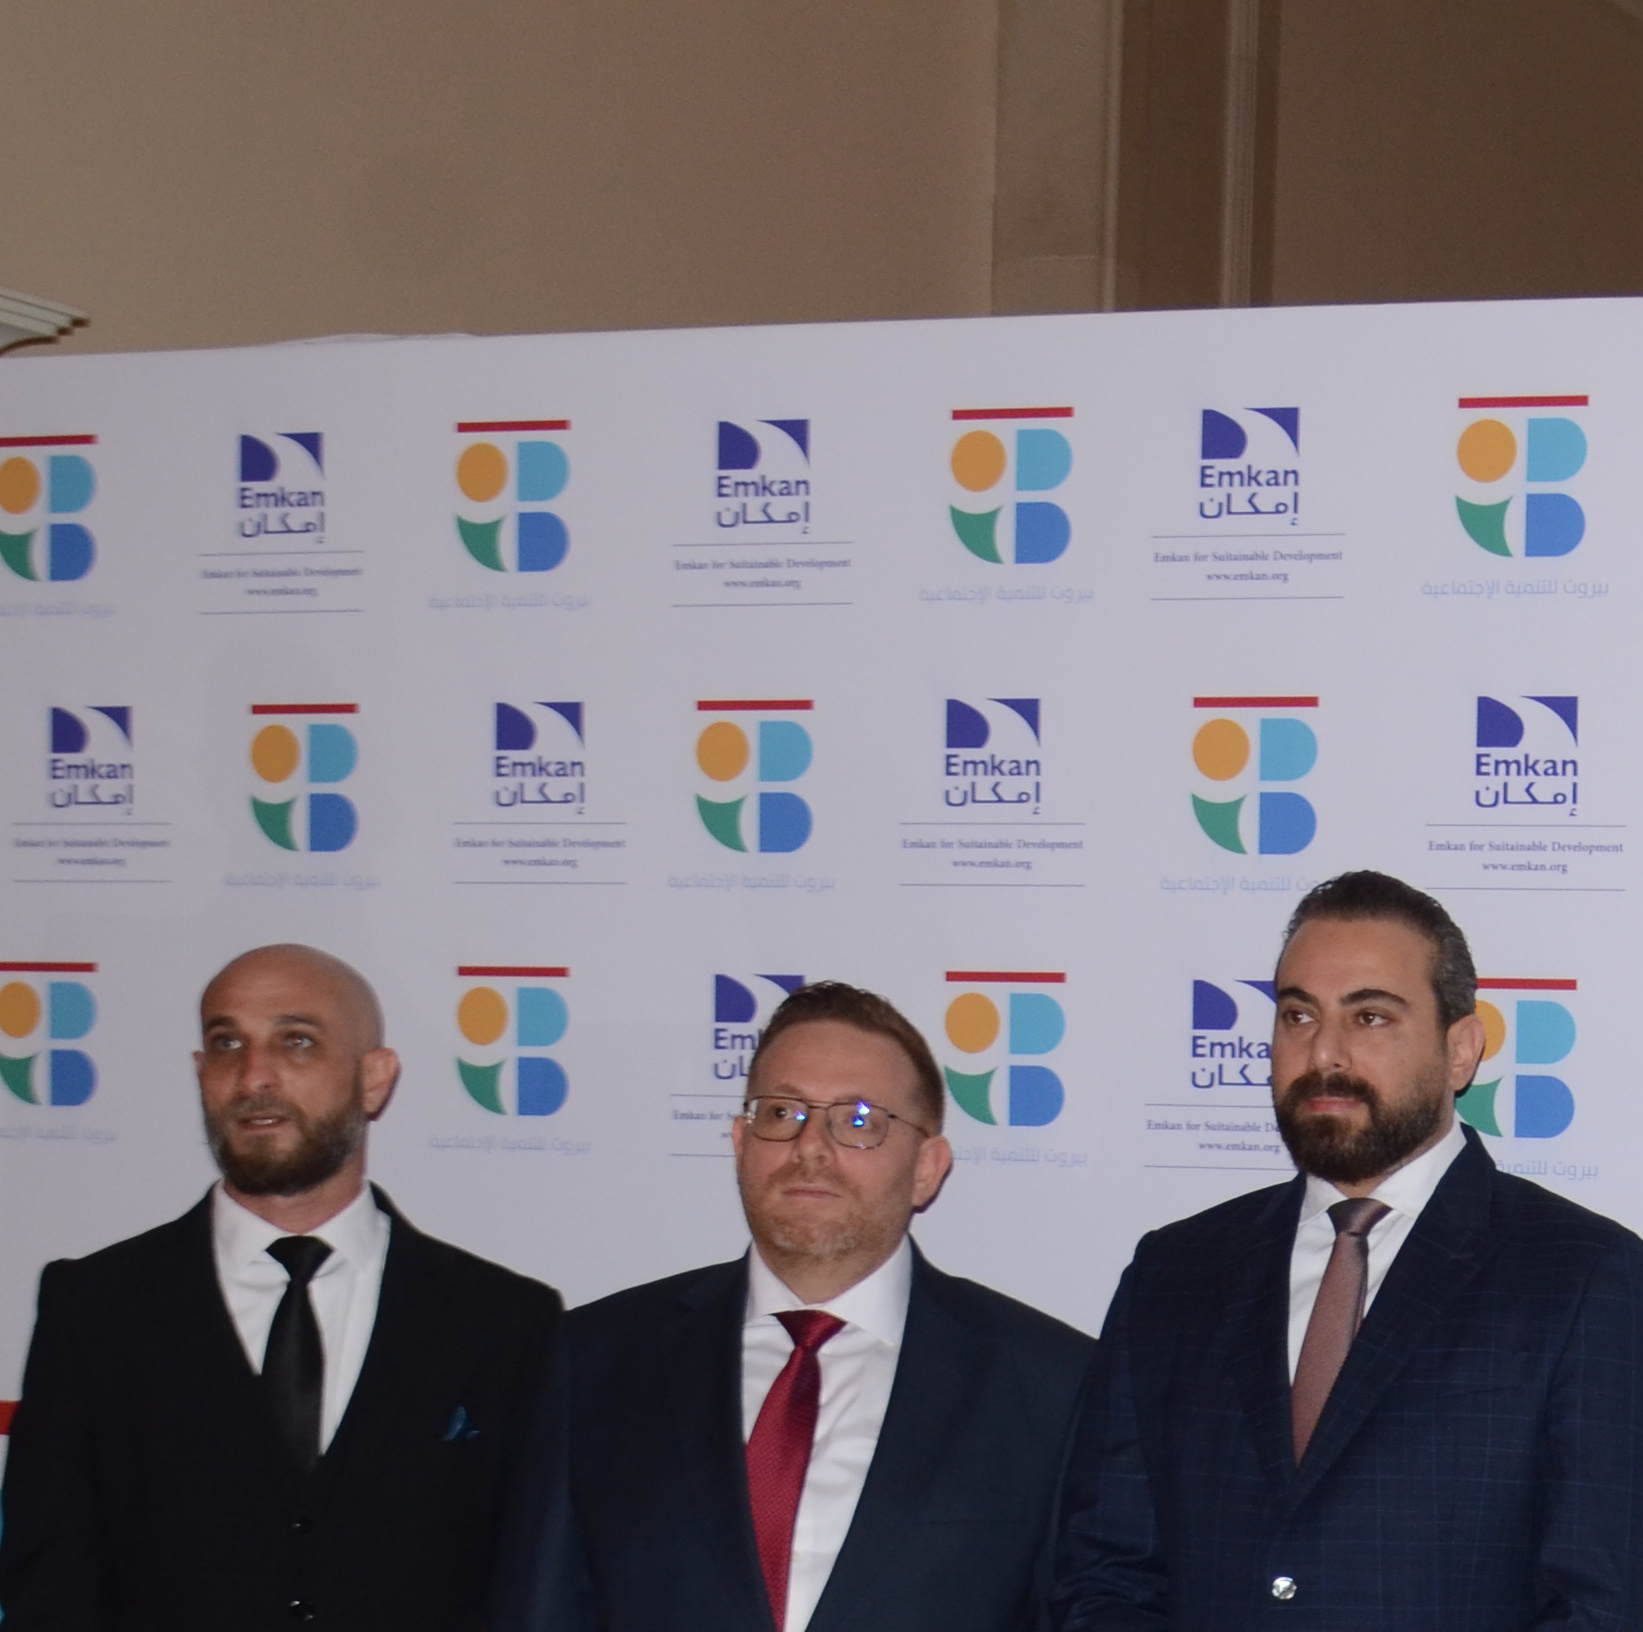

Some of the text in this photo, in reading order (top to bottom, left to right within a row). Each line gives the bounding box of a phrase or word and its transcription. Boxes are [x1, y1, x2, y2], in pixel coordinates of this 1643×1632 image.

[717, 475, 809, 497] Emkan
[1200, 465, 1299, 487] Emkan
[240, 487, 324, 508] Emkan
[51, 759, 133, 779] Emkan
[495, 756, 584, 777] Emkan
[946, 754, 1040, 776] Emkan
[1476, 754, 1578, 776] Emkan
[1428, 840, 1466, 851] Emkan
[1469, 841, 1485, 851] for
[1551, 841, 1623, 855] Development
[1482, 861, 1568, 874] www.emkan.org
[1192, 1035, 1271, 1058] Emka
